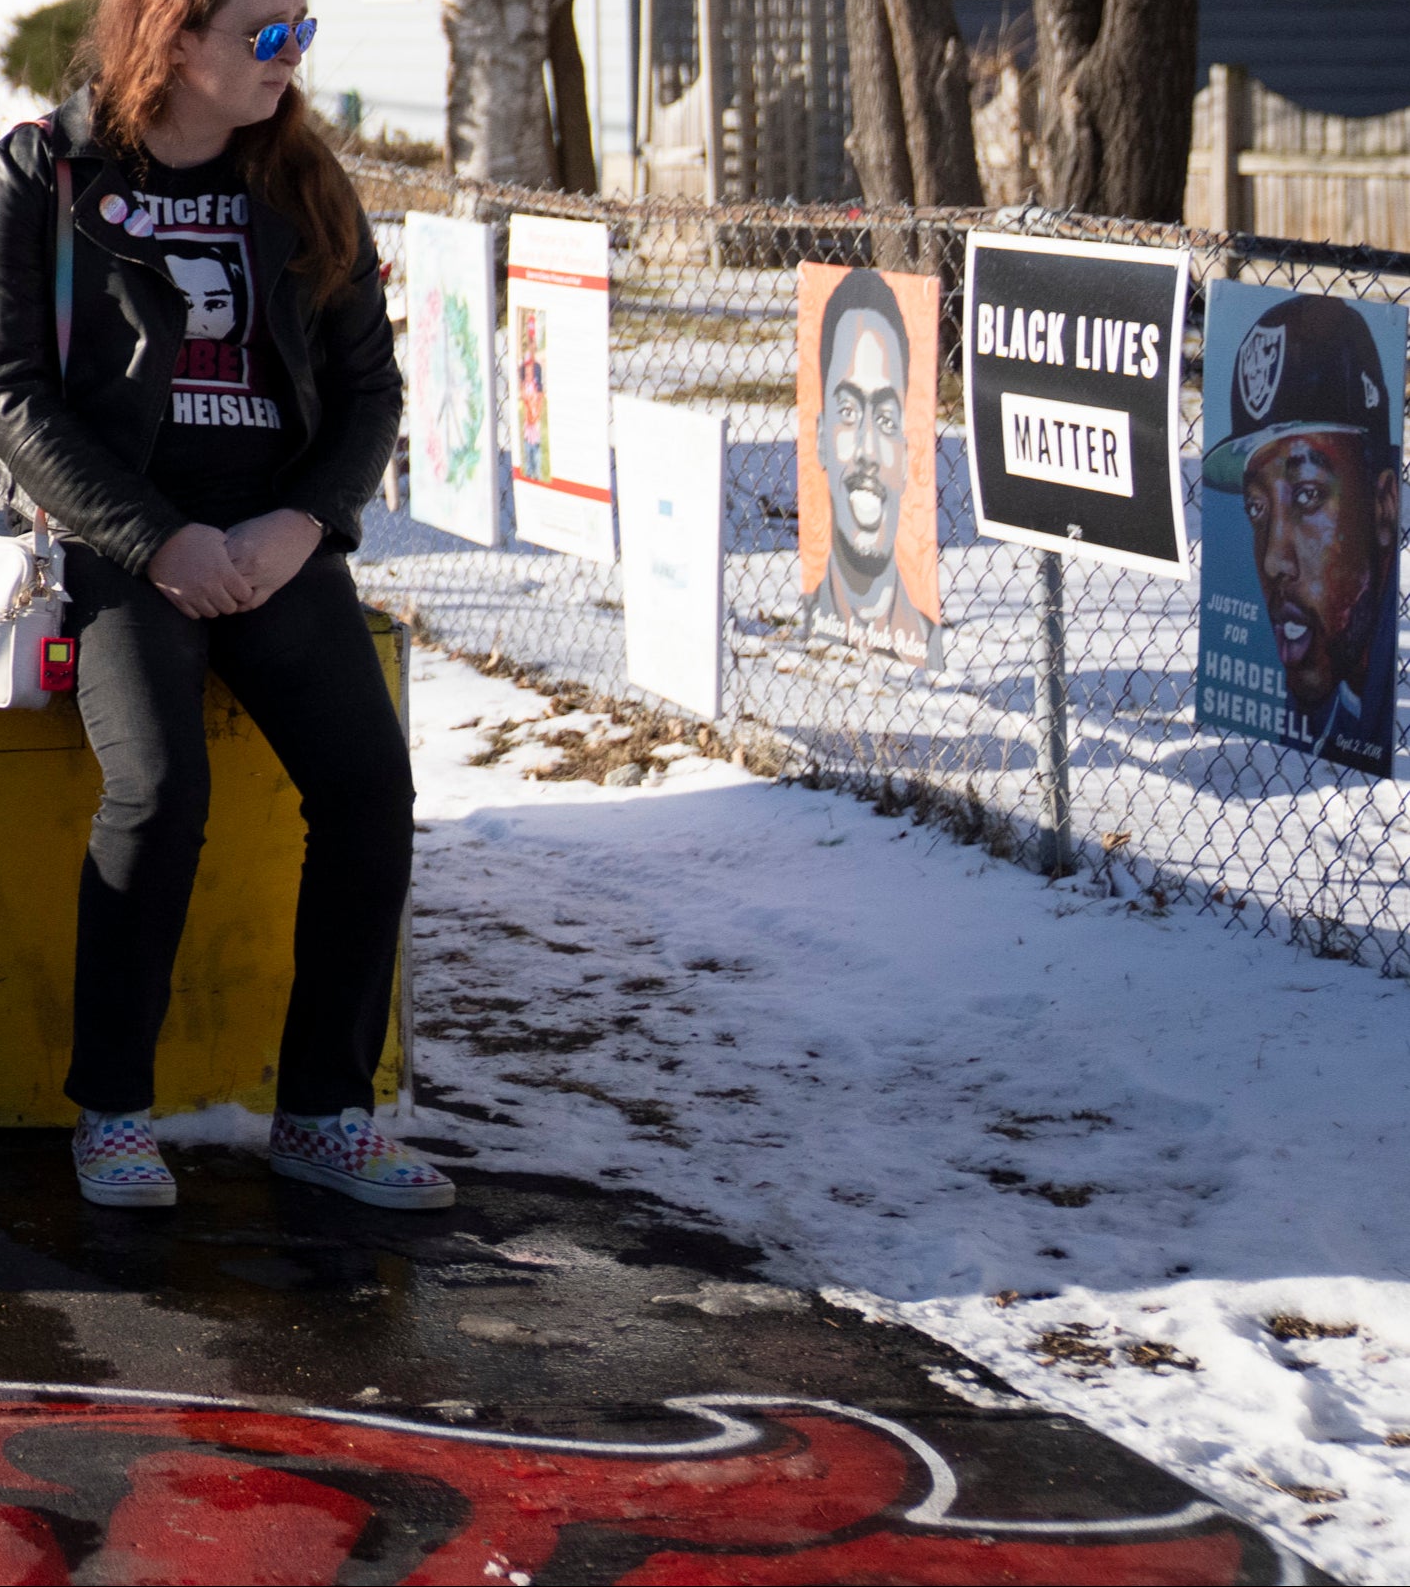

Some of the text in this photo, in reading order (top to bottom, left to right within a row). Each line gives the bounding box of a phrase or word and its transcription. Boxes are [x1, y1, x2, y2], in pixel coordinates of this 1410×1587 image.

[977, 302, 1160, 380] BLACK LIVES
[172, 392, 281, 429] HEISLER
[1014, 413, 1119, 478] MATTER
[1206, 594, 1259, 622] JUSTICE
[1223, 623, 1249, 646] FOR
[1205, 650, 1288, 700] HARDEL
[1203, 686, 1313, 744] SHERRELL
